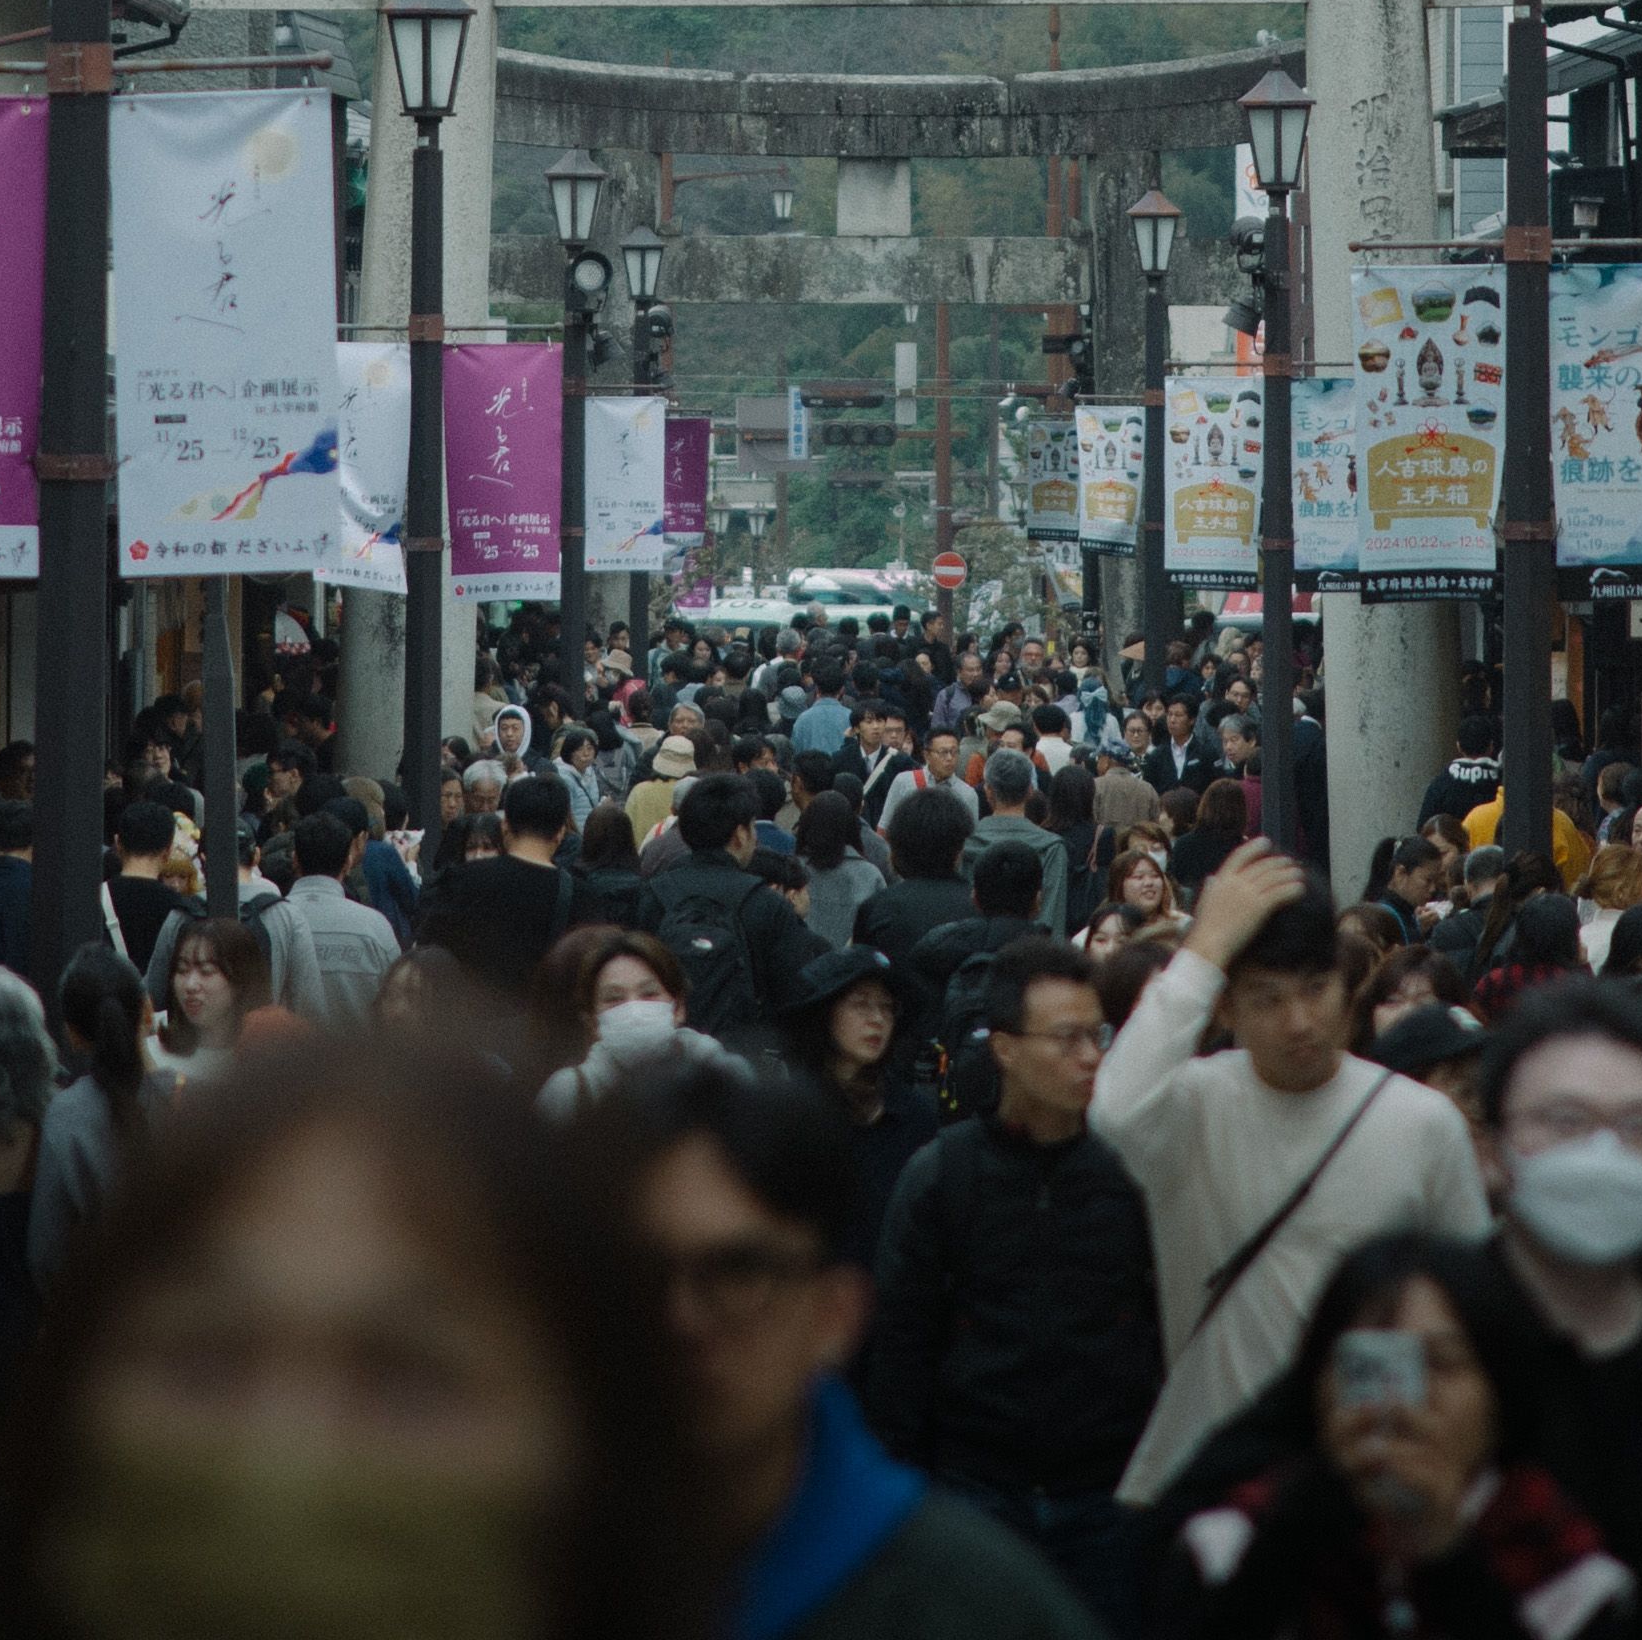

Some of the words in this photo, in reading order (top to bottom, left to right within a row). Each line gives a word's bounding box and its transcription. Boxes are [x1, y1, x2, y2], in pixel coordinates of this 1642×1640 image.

[1558, 364, 1642, 392] 襲来の
[1296, 441, 1351, 459] 襲来の
[1375, 454, 1489, 479] 人吉球磨の
[1397, 483, 1470, 506] 玉手箱
[154, 539, 227, 558] 令和の都
